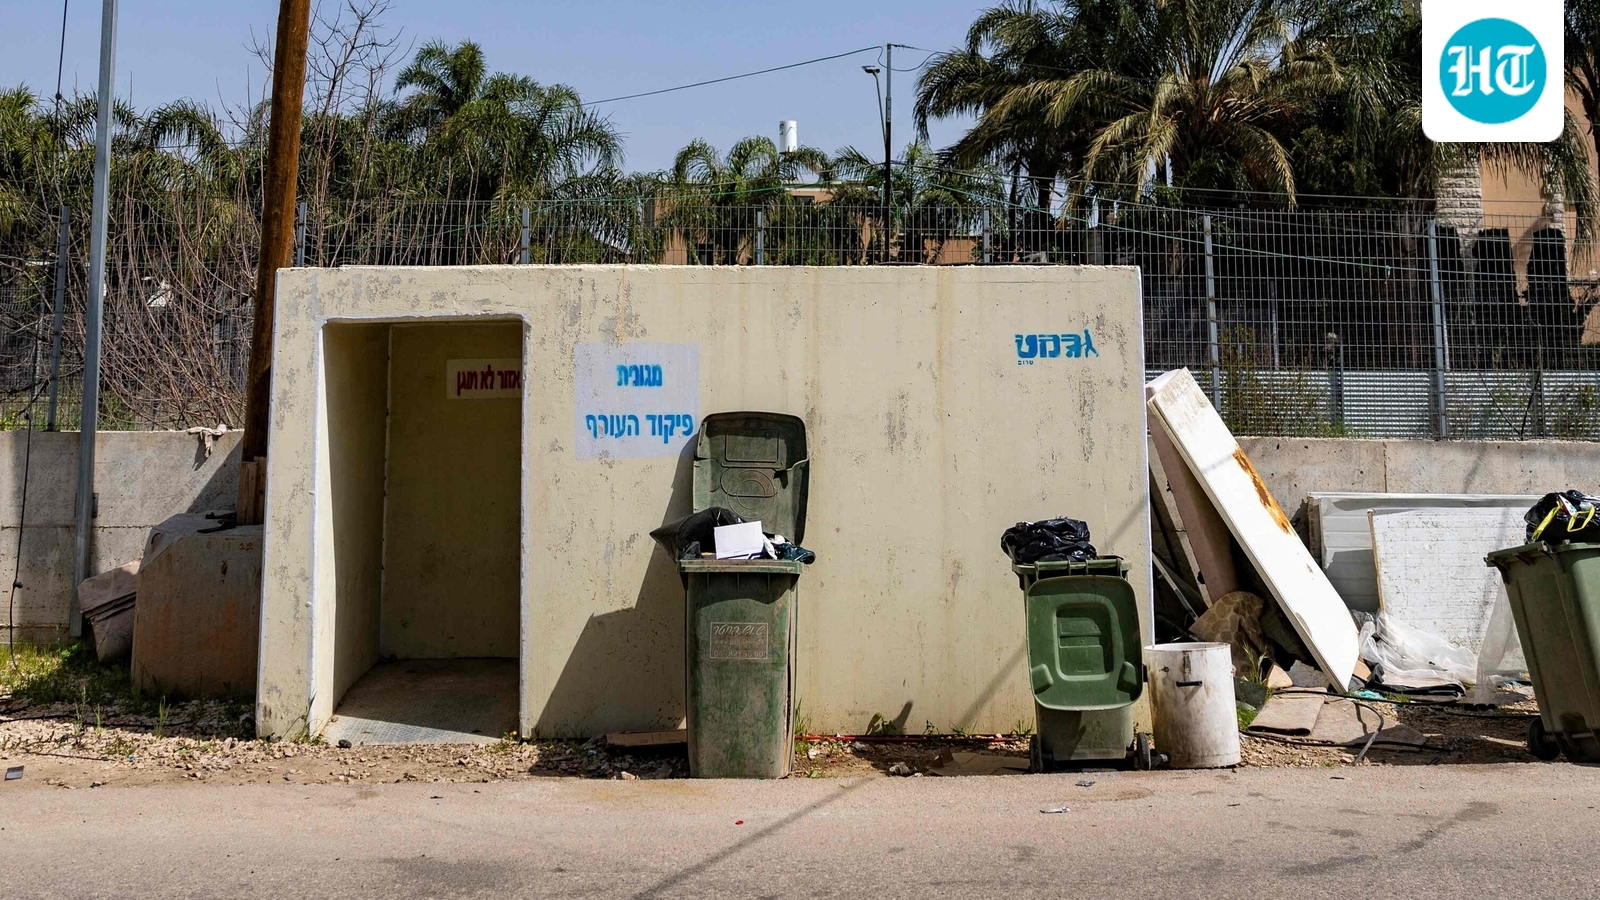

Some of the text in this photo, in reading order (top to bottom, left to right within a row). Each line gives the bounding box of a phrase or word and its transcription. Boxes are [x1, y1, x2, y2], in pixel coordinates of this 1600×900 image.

[480, 364, 495, 390] לא
[616, 363, 664, 388] מגונית
[585, 413, 695, 445] פיקוד העורף
